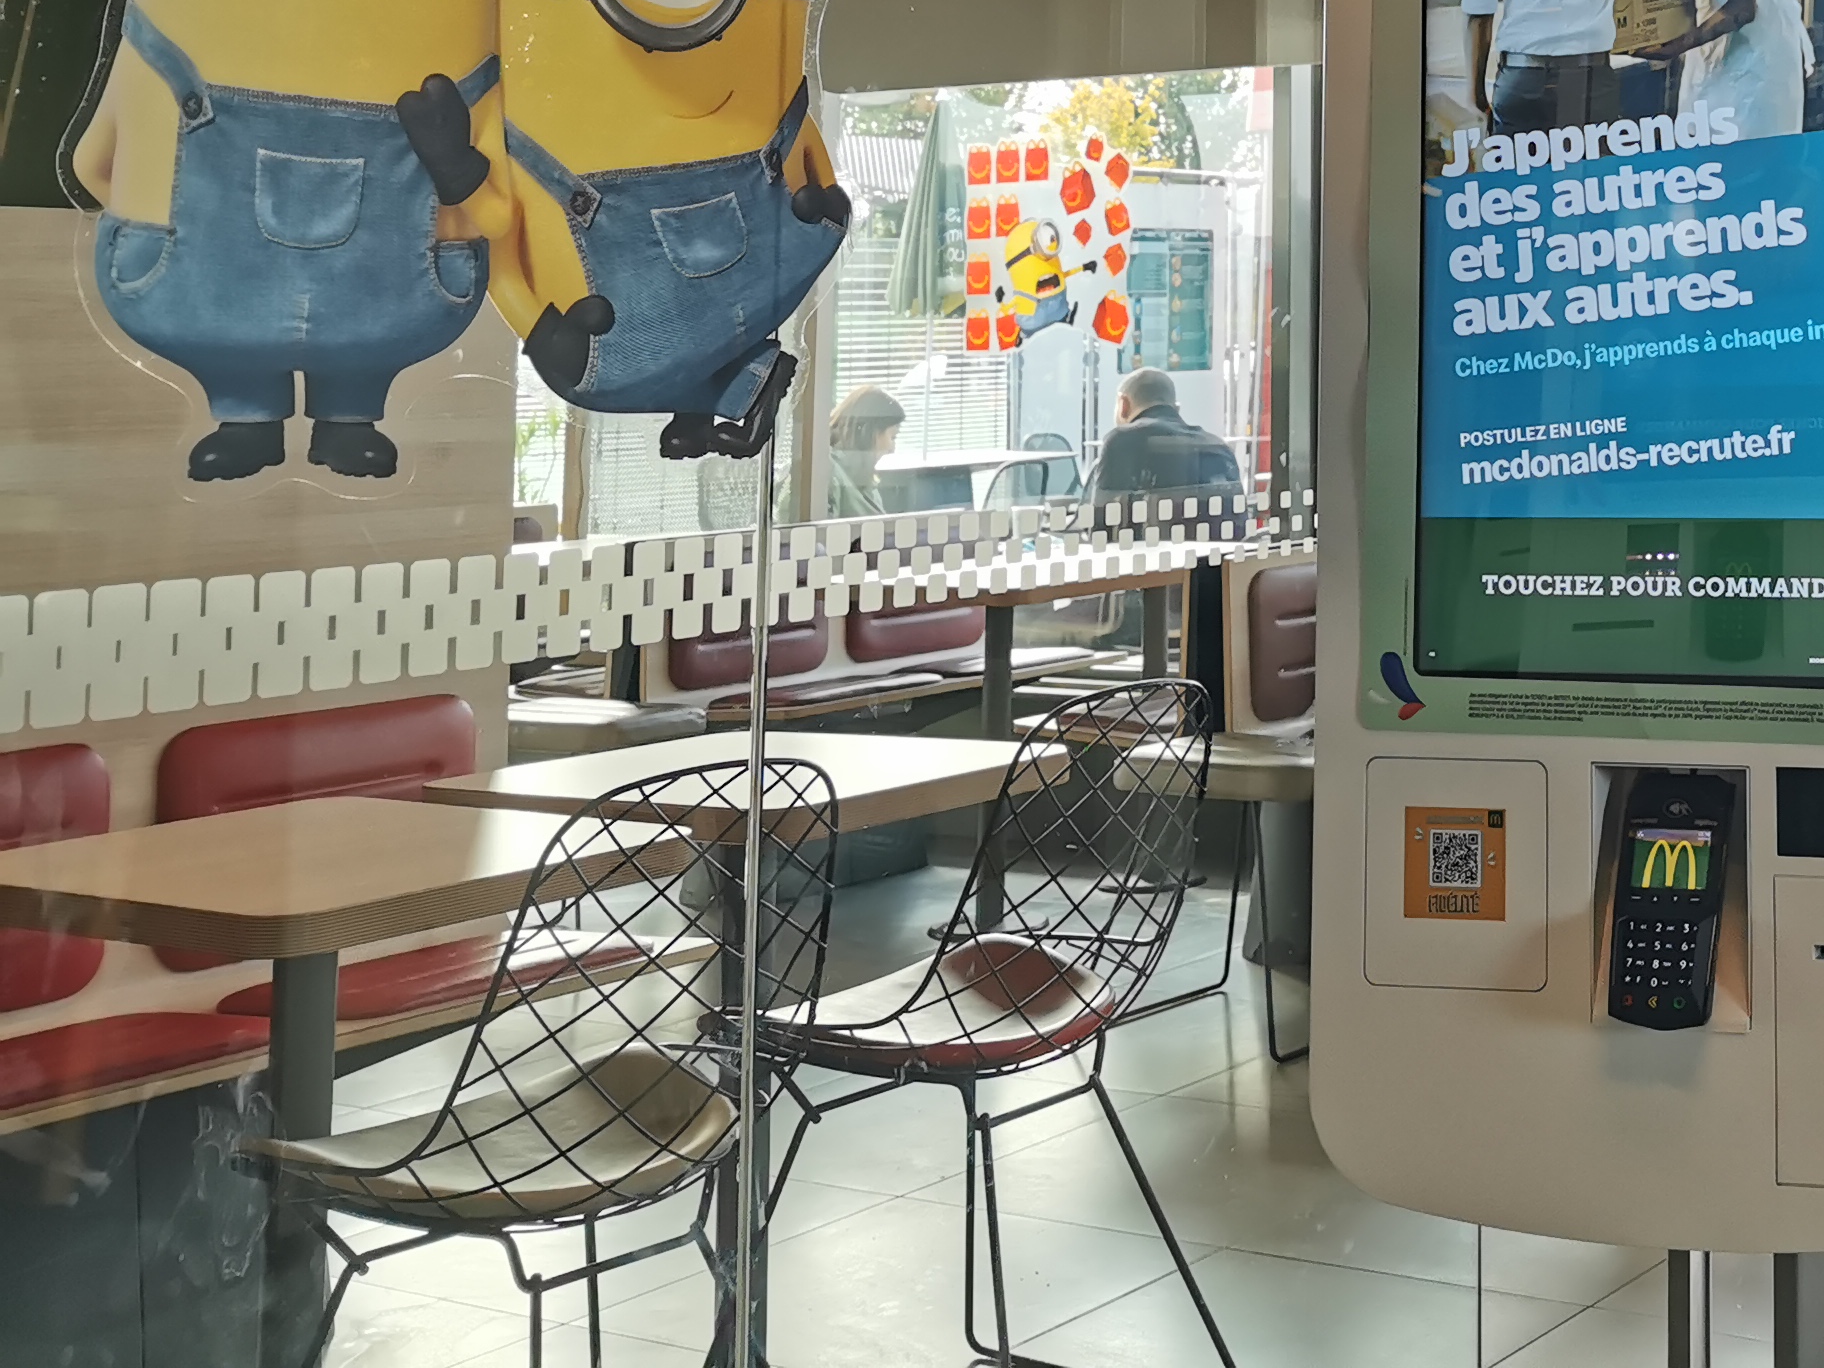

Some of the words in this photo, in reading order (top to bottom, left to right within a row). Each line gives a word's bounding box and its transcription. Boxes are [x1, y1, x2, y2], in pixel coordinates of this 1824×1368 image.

[1441, 100, 1739, 178] J'apprends
[1445, 181, 1541, 230] des
[1552, 161, 1726, 218] autres
[1449, 236, 1504, 282] et
[1514, 199, 1808, 283] j'apprends
[1452, 288, 1555, 336] aux
[1565, 269, 1753, 325] autres.
[1455, 356, 1510, 378] Chez
[1514, 348, 1582, 372] McDo,
[1583, 334, 1700, 370] j'apprends
[1703, 330, 1717, 351] à
[1721, 327, 1804, 350] chaque
[1459, 425, 1547, 447] POSTULEZ
[1549, 422, 1573, 439] EN
[1576, 417, 1628, 436] LIGNE
[1461, 424, 1796, 485] mcdonalds-recrute.fr
[1481, 574, 1604, 597] TOUCHEZ
[1610, 575, 1682, 597] POUR
[1626, 939, 1634, 949] 4
[1654, 940, 1661, 951] 5
[1681, 942, 1689, 952] 6
[1655, 922, 1663, 933] 2
[1683, 923, 1690, 934] 3
[1626, 957, 1633, 968] 7
[1652, 959, 1660, 970] 8
[1679, 959, 1687, 970] 9
